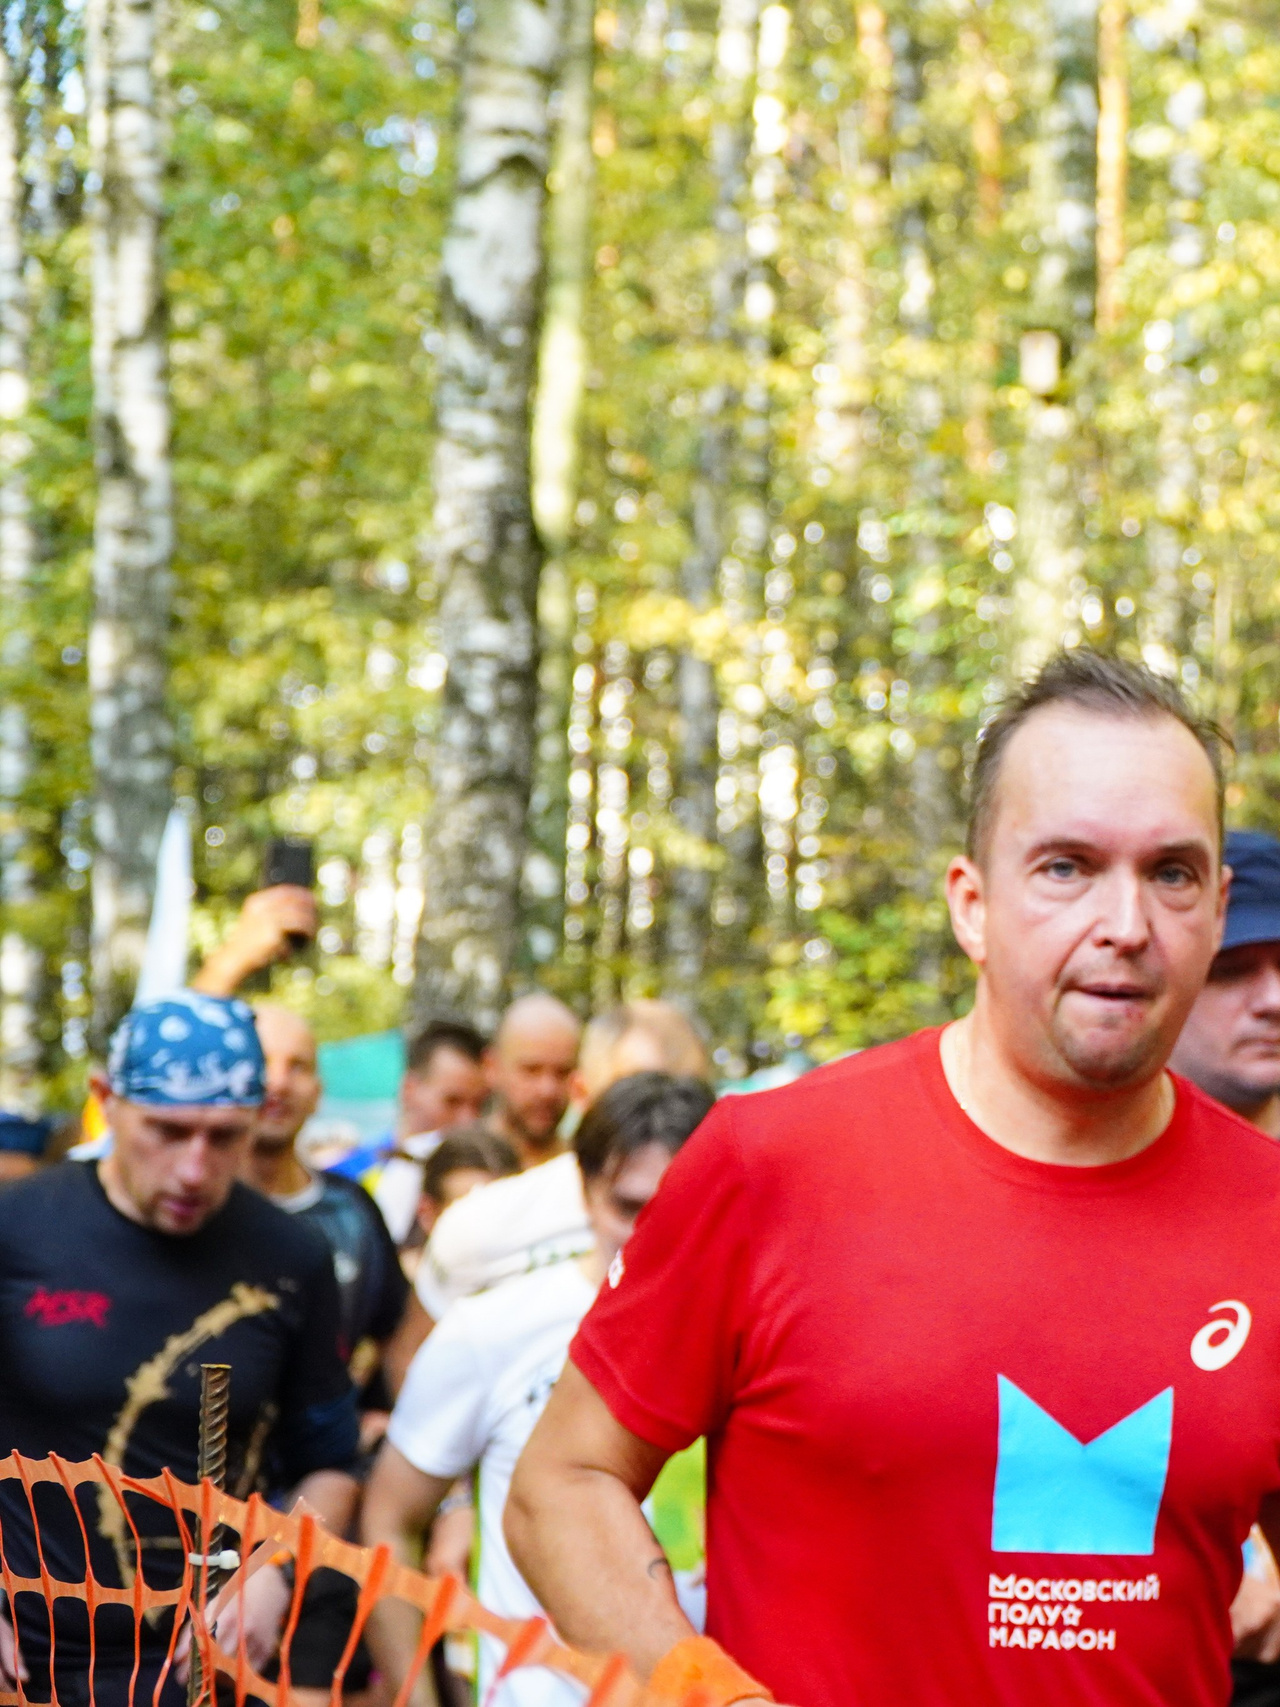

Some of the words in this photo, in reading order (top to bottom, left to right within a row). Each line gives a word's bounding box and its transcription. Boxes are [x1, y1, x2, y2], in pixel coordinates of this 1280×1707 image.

[988, 1573, 1160, 1602] МОСКОВСКИЙ
[987, 1601, 1063, 1626] ПОЛУ
[988, 1626, 1117, 1650] МАРАФОН
